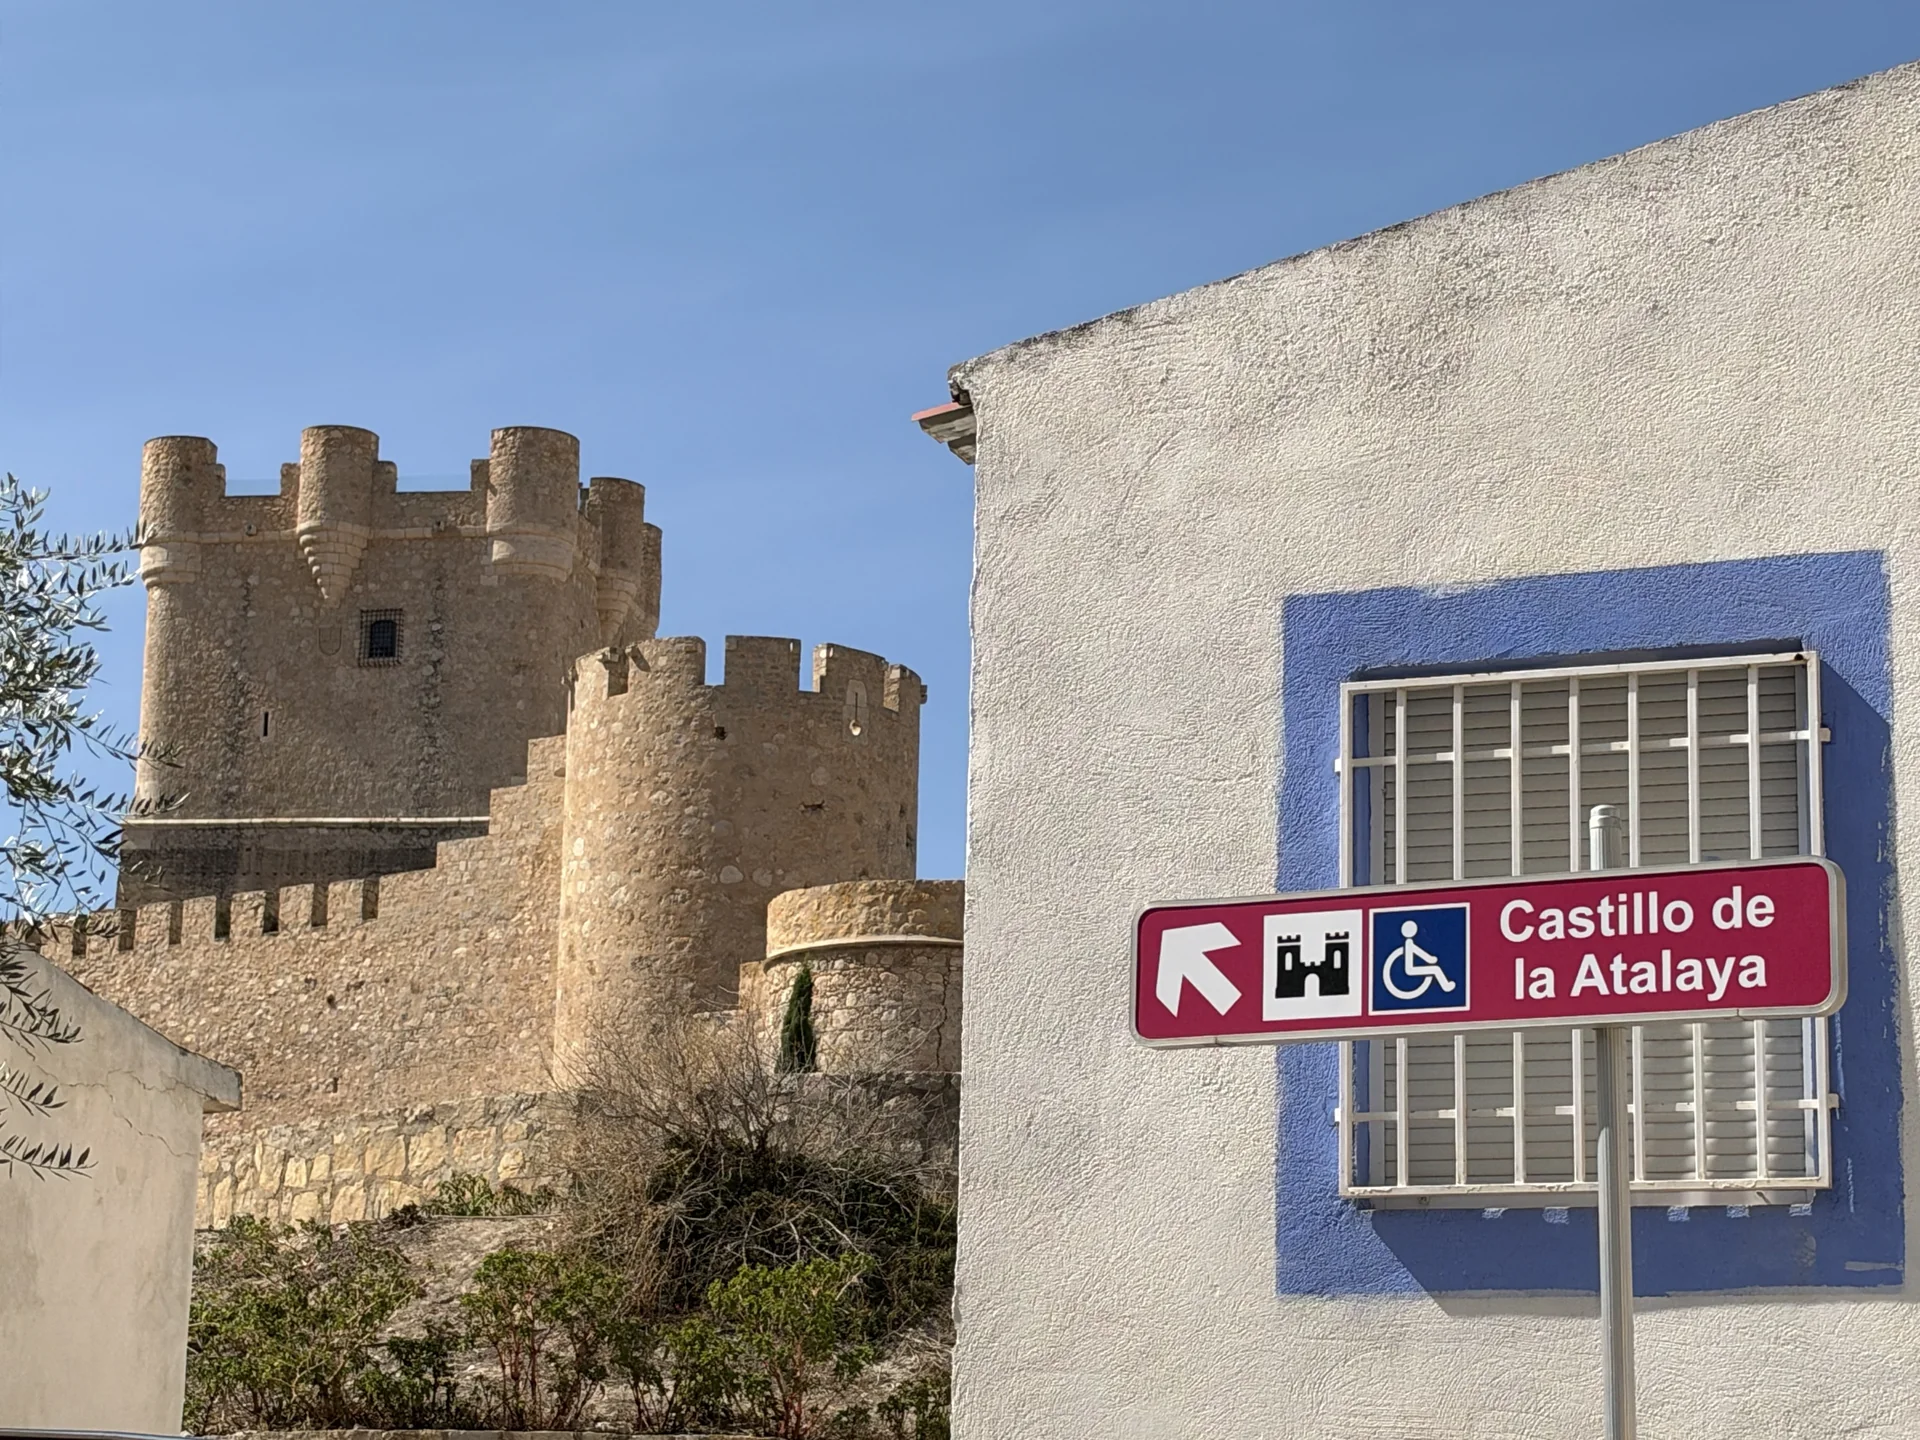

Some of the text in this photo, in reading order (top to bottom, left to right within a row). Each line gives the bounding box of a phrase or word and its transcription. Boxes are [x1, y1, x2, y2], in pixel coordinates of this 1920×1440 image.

[1499, 885, 1775, 943] Castillo de
[1515, 949, 1767, 1002] la Atalaya
